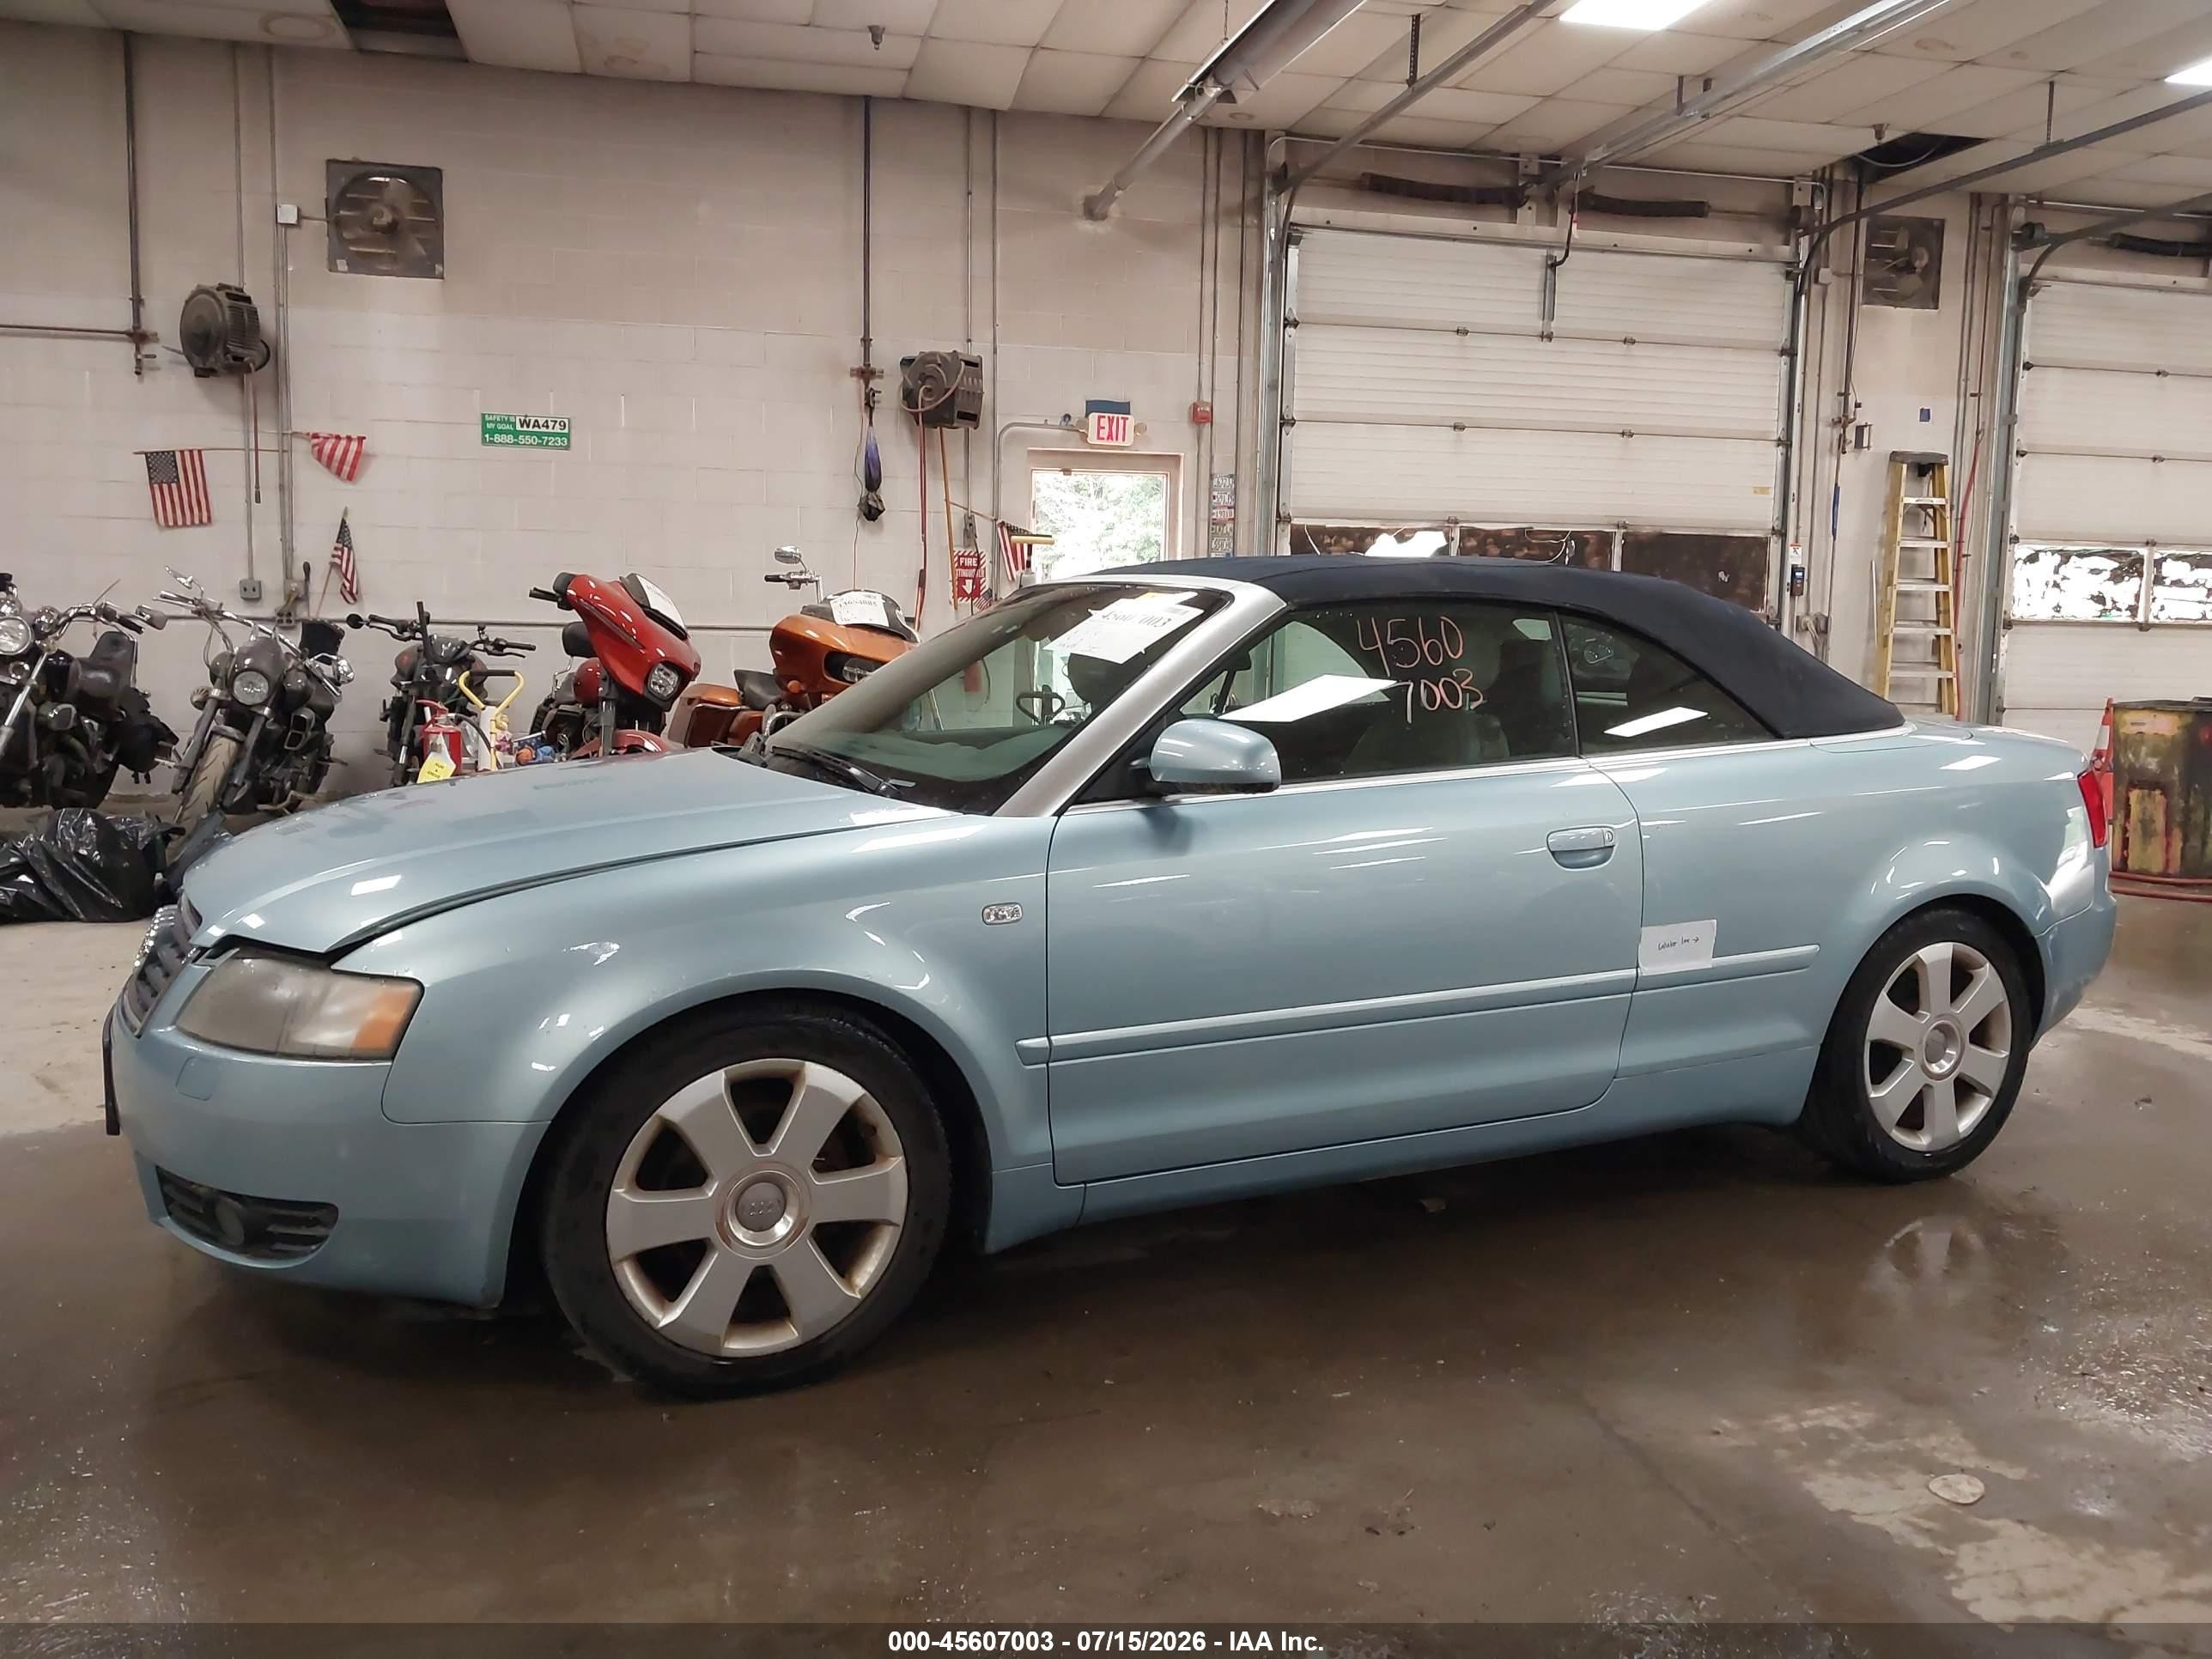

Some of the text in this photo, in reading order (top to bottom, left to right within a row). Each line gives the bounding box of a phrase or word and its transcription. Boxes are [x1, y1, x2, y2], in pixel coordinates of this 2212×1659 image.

[519, 418, 567, 431] WA479
[1097, 416, 1129, 442] EXIT
[484, 433, 568, 447] 1-888-550-7233
[959, 557, 978, 567] FIRE
[1357, 616, 1464, 677] 4560
[1380, 668, 1485, 724] 7003
